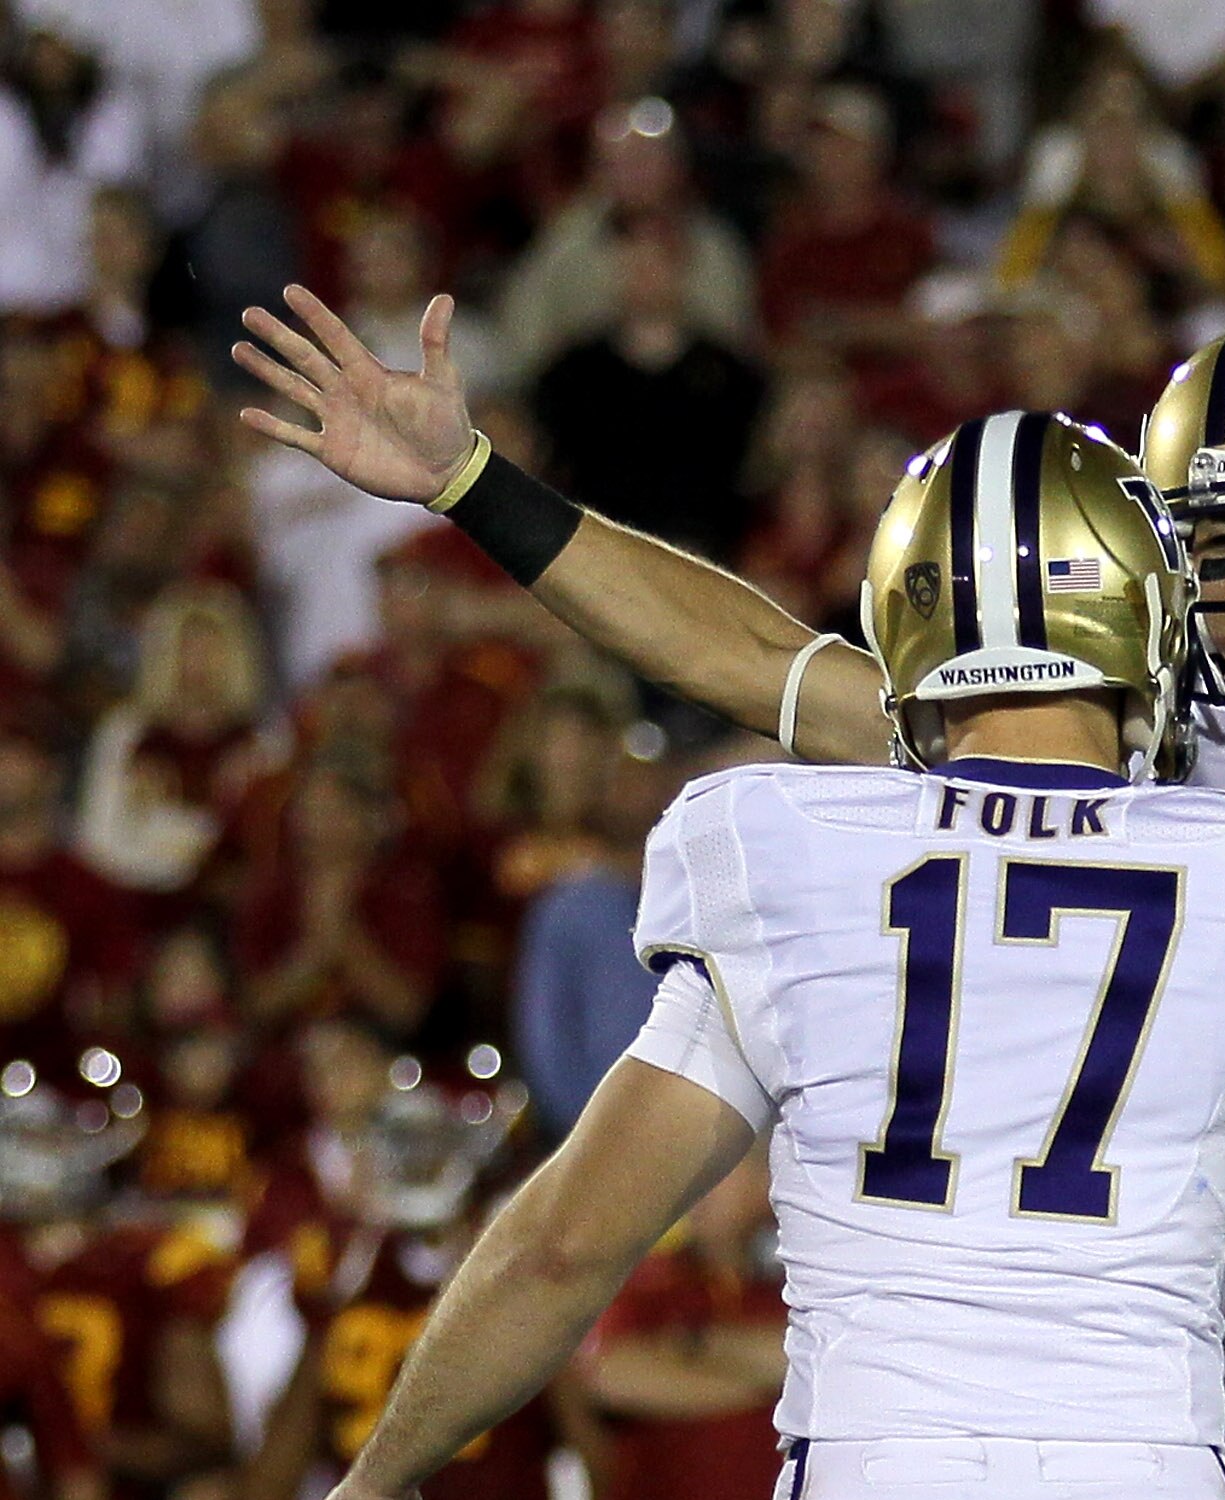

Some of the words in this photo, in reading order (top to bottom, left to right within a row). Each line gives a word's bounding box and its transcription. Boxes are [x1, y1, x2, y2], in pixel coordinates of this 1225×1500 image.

[940, 661, 1075, 685] WASHINGTON
[936, 784, 1109, 840] FOLK
[853, 852, 1187, 1226] 17
